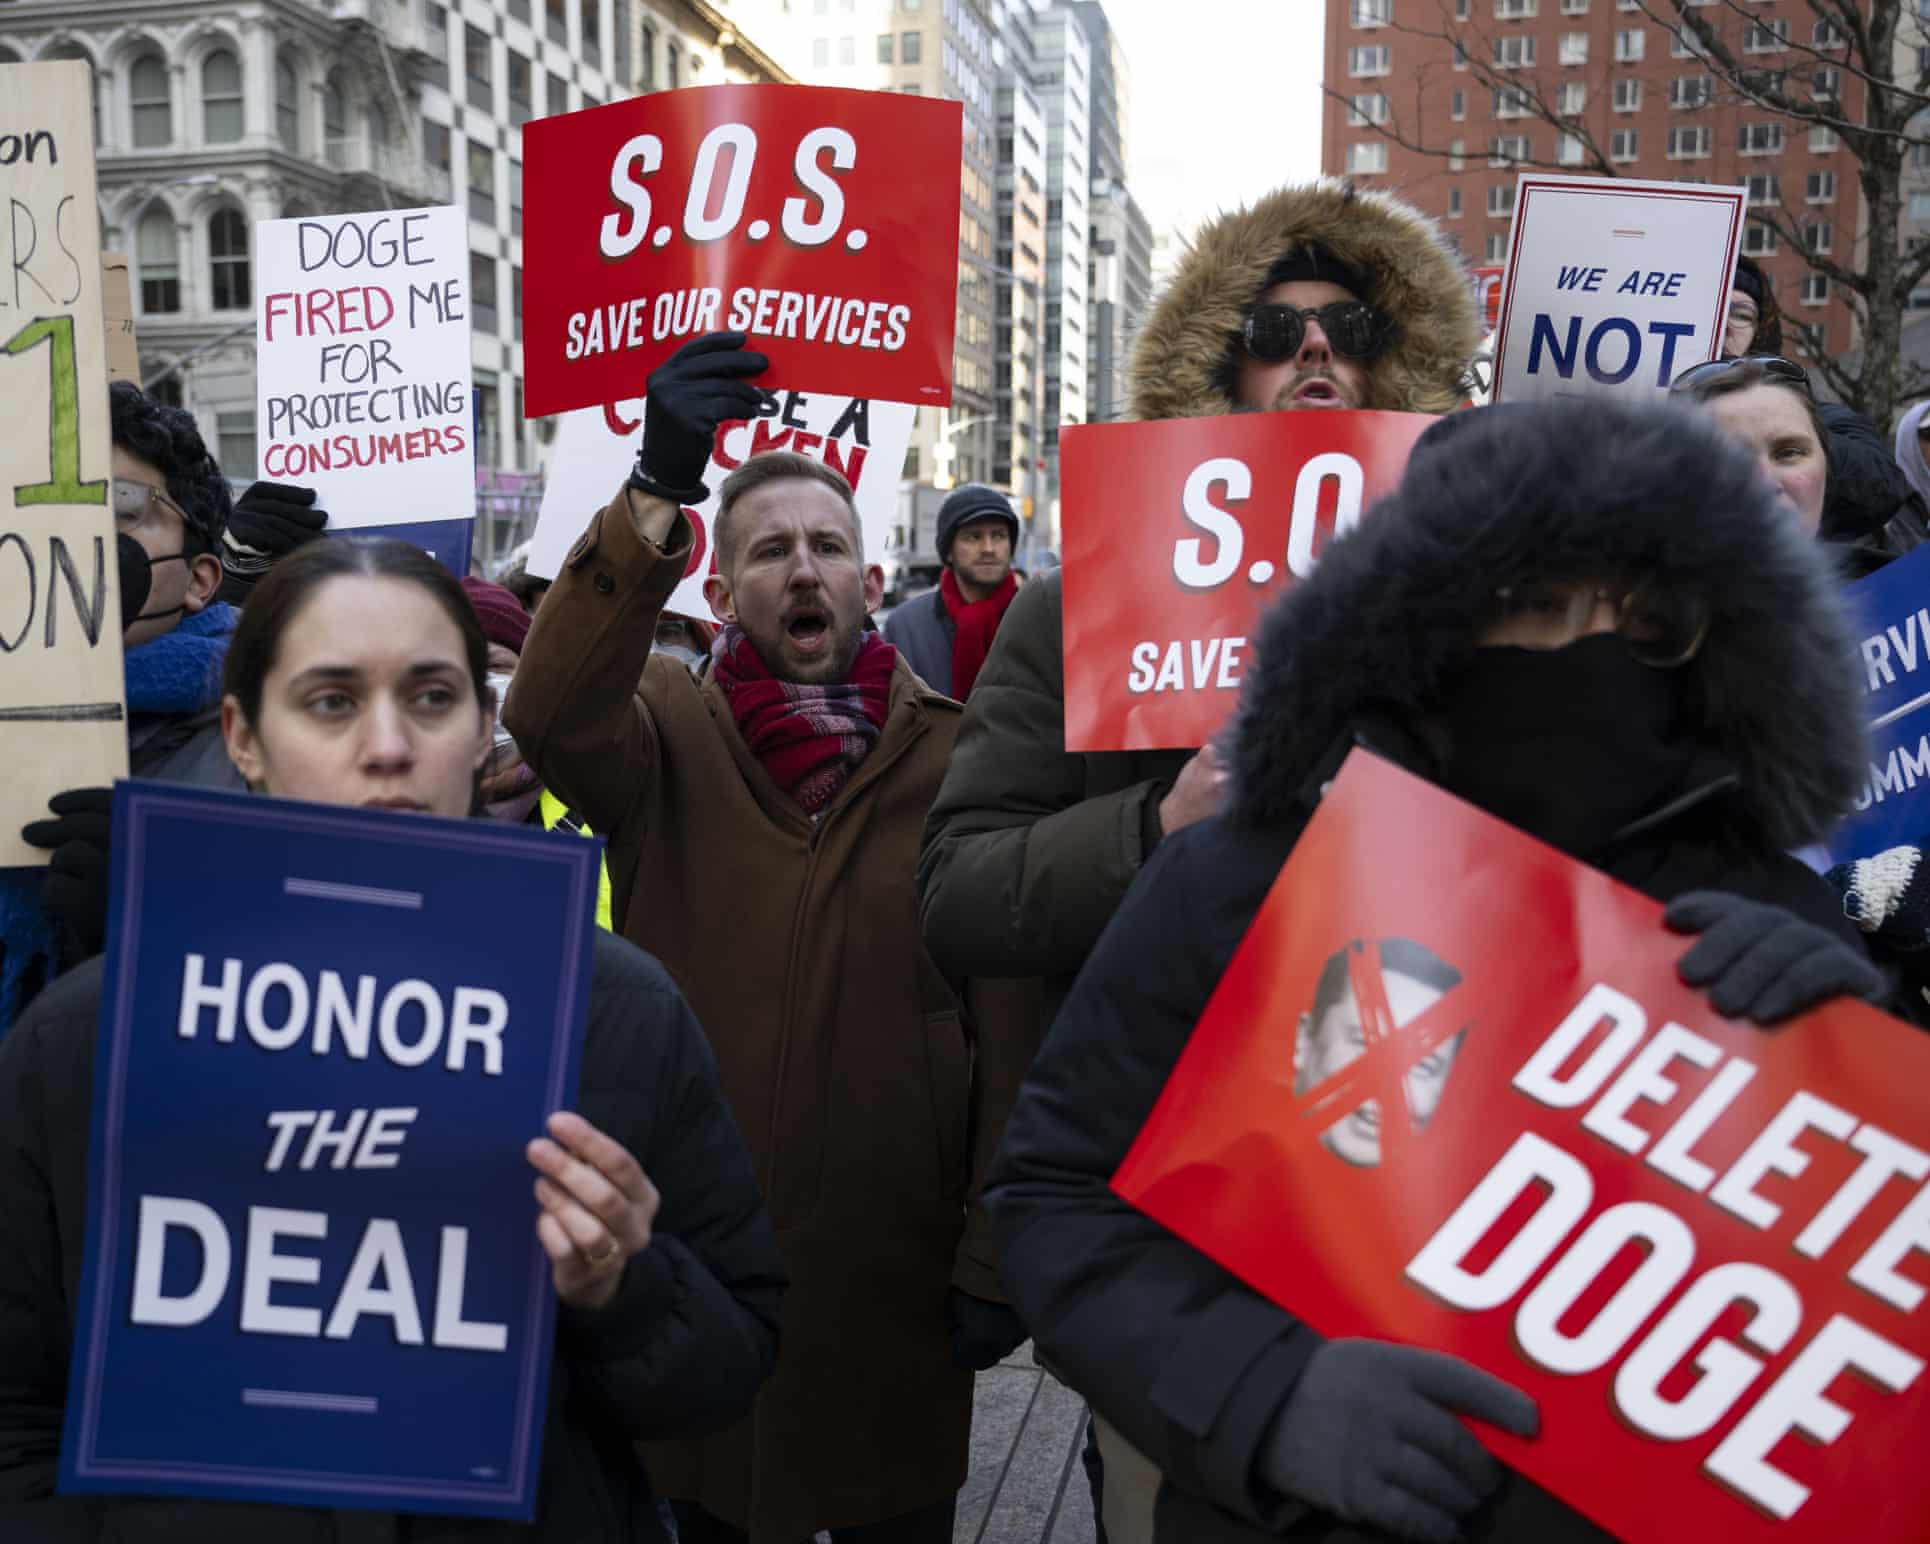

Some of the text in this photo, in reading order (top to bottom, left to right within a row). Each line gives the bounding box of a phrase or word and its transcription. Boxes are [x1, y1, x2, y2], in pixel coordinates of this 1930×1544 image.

[599, 123, 868, 258] S.O.S.
[0, 195, 81, 309] RS
[299, 215, 435, 271] DOGE
[265, 279, 464, 341] FIRED ME
[1556, 266, 1687, 297] WE ARE
[565, 287, 911, 360] SAVE OUR SERVICES
[1526, 313, 1696, 388] NOT
[320, 340, 402, 384] FOR
[267, 381, 464, 440] PROTECTING
[828, 396, 870, 447] A
[264, 427, 465, 477] CONSUMERS
[1128, 637, 1247, 692] SAVE
[178, 953, 509, 1075] HONOR
[265, 1107, 417, 1171] THE
[131, 1195, 508, 1351] DEAL
[1405, 1131, 1925, 1522] DOGE
